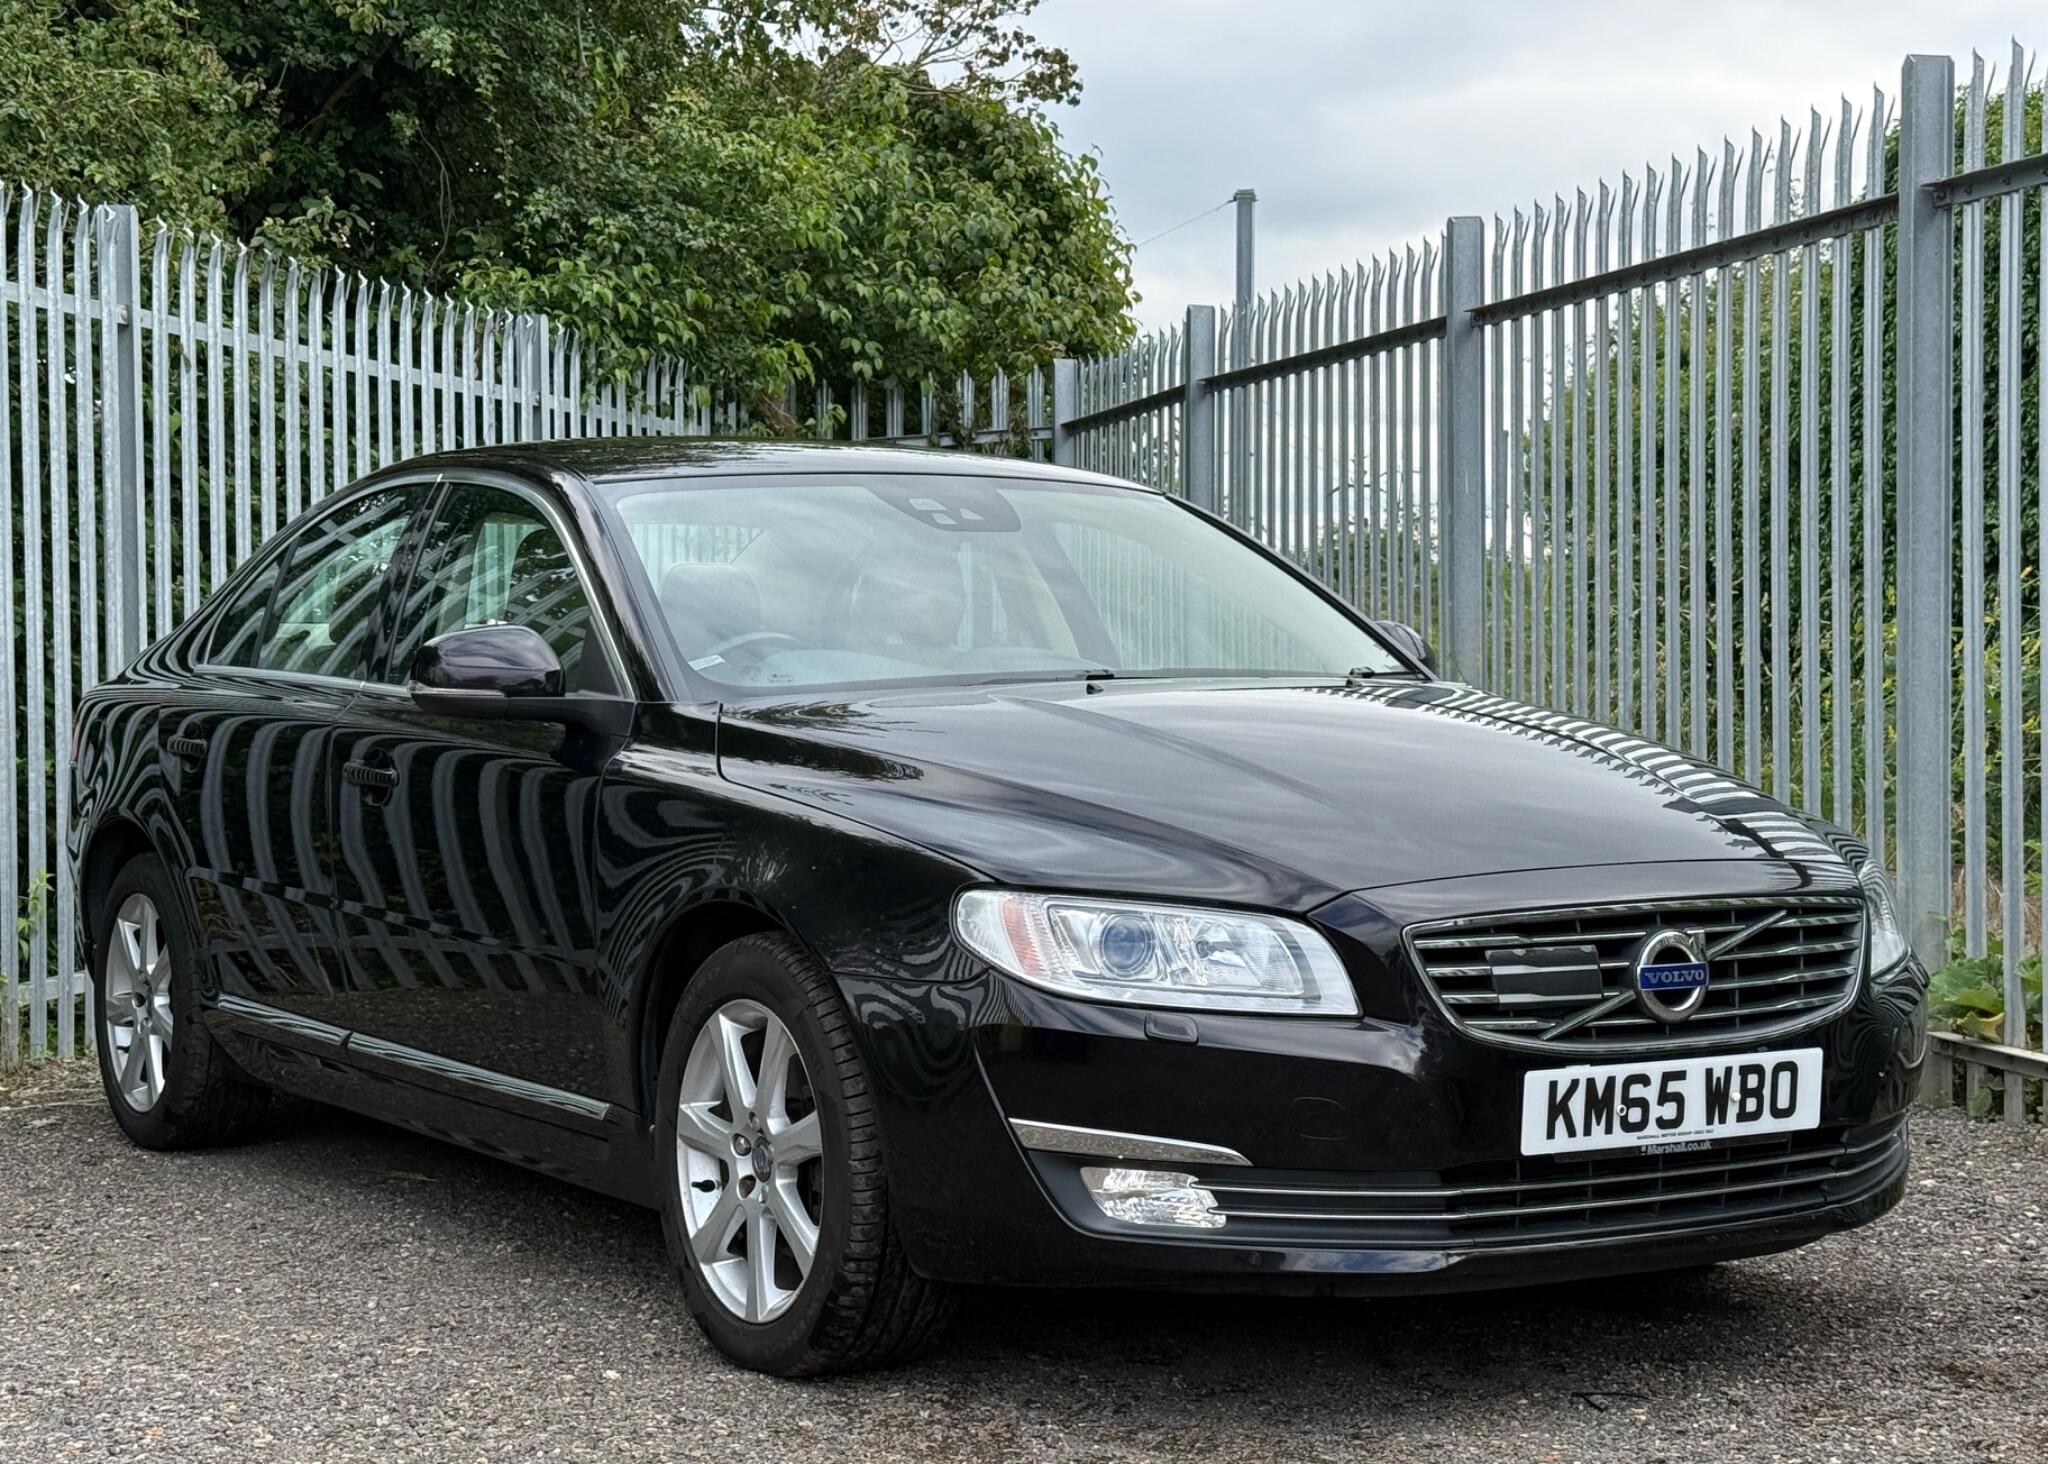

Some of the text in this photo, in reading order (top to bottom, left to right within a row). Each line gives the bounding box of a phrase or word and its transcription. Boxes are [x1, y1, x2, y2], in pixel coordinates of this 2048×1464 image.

[1645, 970, 1704, 983] VOLVO
[1546, 1060, 1799, 1140] KM65 WBO
